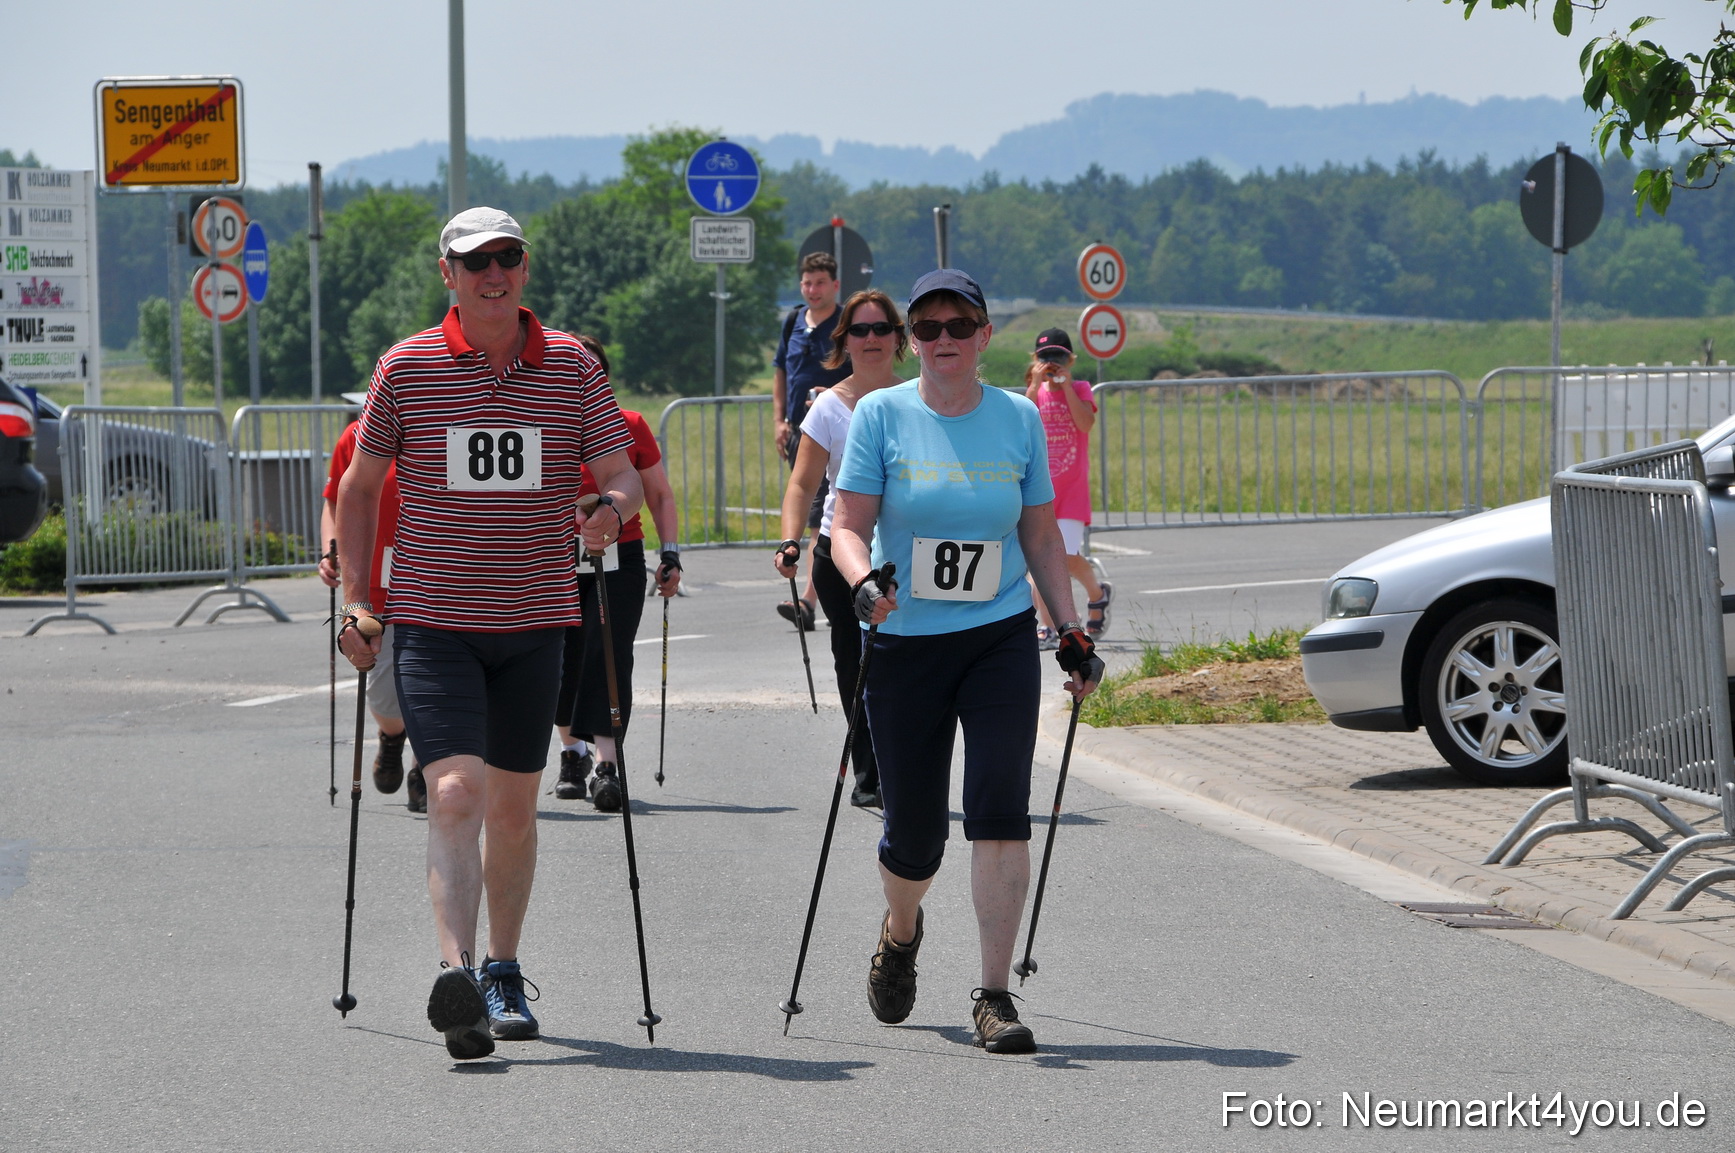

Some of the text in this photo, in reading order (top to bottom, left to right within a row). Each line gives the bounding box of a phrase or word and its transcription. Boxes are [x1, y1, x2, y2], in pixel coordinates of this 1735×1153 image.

[115, 97, 225, 129] Sengenthal
[130, 131, 210, 149] am Anger
[143, 159, 191, 172] Neumarkt
[27, 172, 71, 188] HOLZAMMER
[28, 208, 72, 224] HOLZAMMER
[702, 224, 742, 233] Landwirt-
[698, 236, 746, 244] schaftlicher
[699, 246, 747, 255] Verkehr frei
[5, 245, 73, 273] SHB Holzfachmarkt
[1090, 261, 1115, 285] 60
[7, 318, 44, 343] THULE
[8, 352, 75, 366] HEIDELBERGCEMENT
[468, 431, 524, 481] 88
[898, 468, 938, 482] AM
[934, 541, 984, 591] 87
